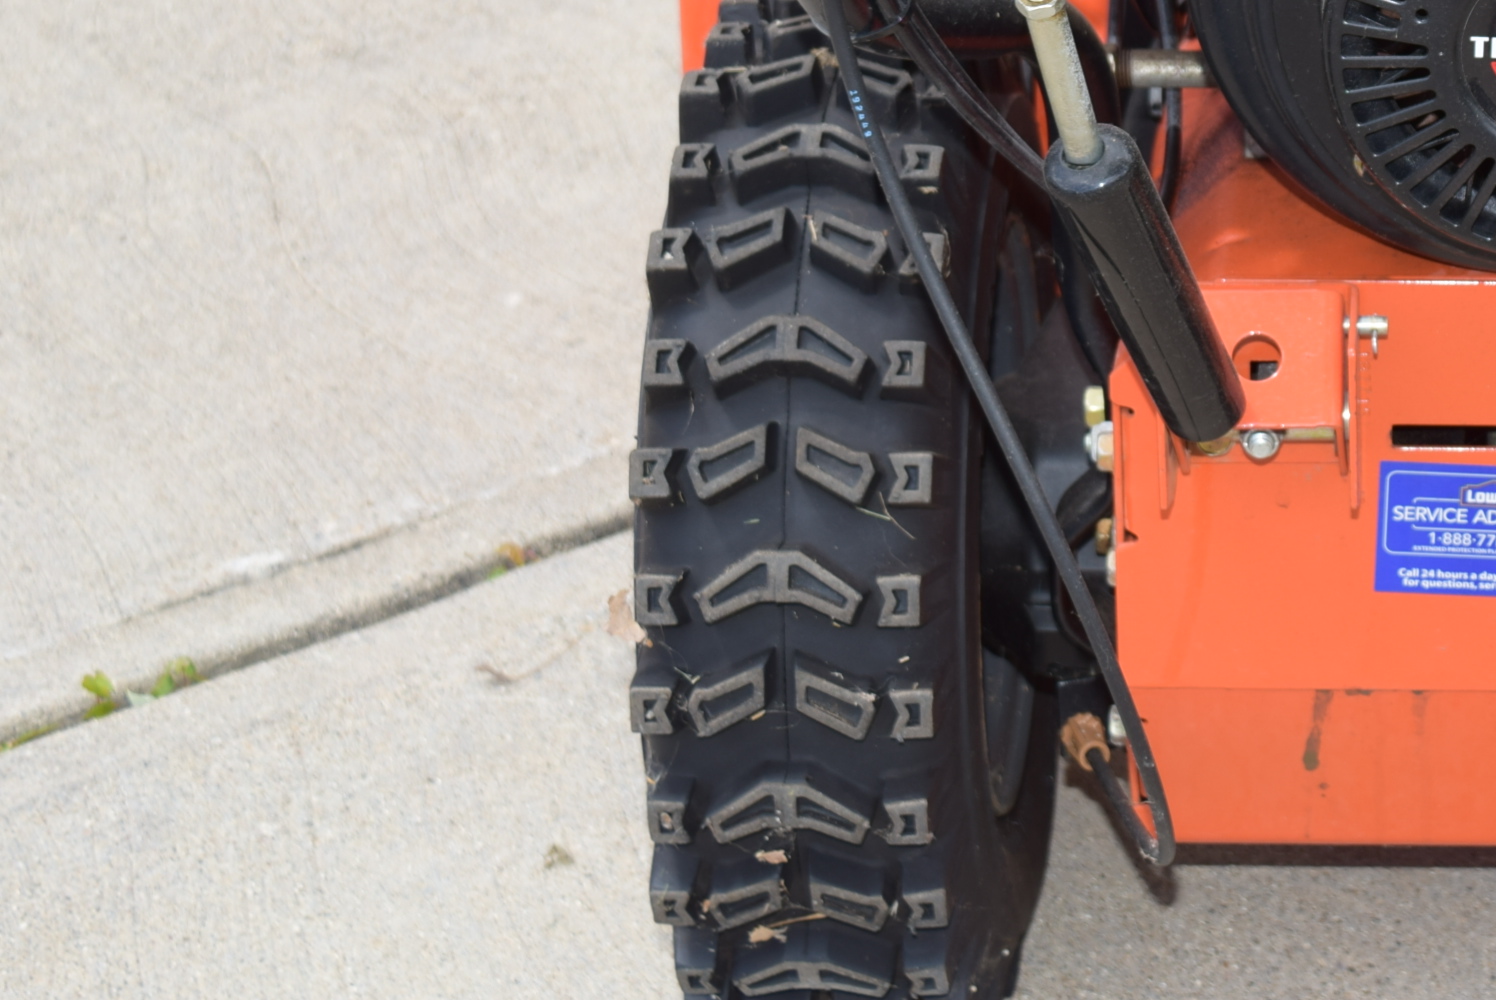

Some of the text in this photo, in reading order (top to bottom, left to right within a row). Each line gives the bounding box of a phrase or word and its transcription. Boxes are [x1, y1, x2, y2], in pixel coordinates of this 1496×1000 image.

[1392, 505, 1469, 524] SERVICE
[1398, 567, 1420, 578] Call
[1421, 569, 1436, 579] 24
[1437, 569, 1469, 580] hours
[1470, 572, 1477, 580] a
[1402, 577, 1420, 587] for
[1421, 579, 1478, 590] questions,
